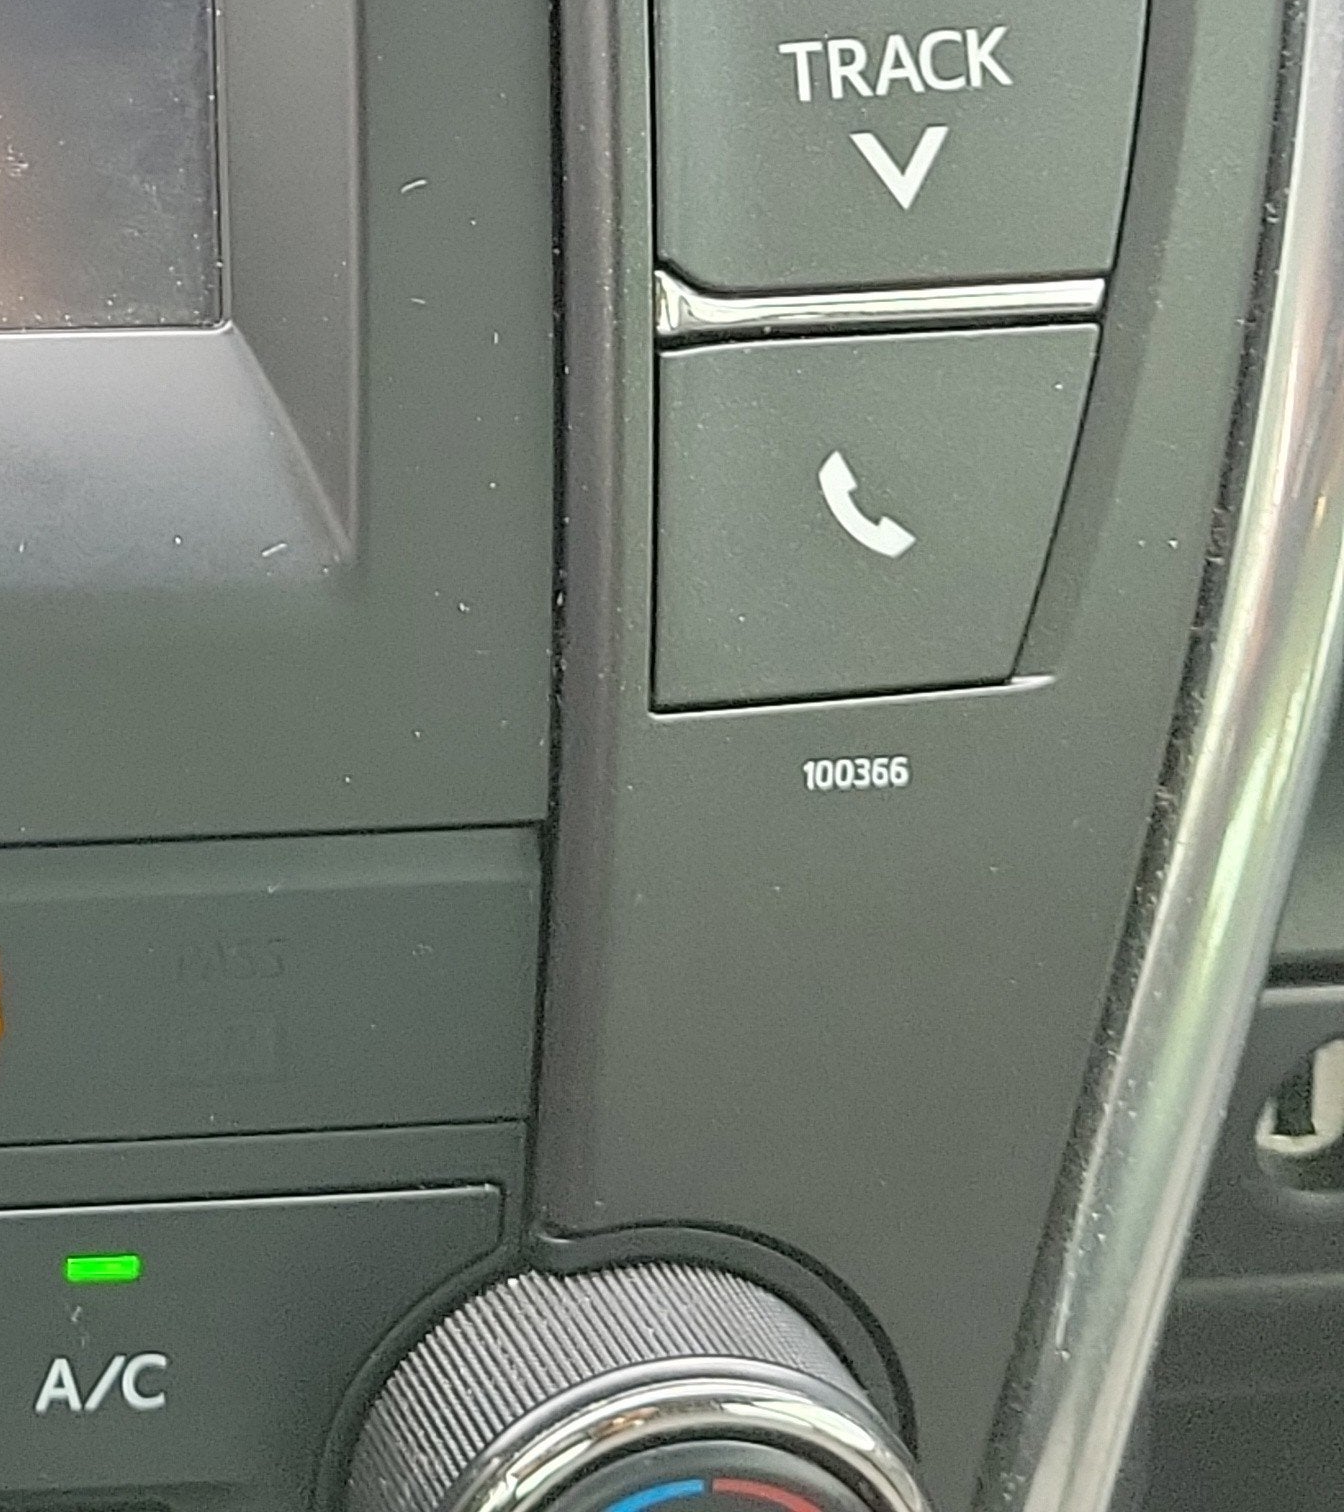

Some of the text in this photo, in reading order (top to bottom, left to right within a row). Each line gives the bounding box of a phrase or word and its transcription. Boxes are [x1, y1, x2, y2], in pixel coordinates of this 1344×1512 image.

[779, 27, 1014, 101] TRACK
[802, 756, 909, 791] 100366
[34, 1353, 168, 1413] A/C
